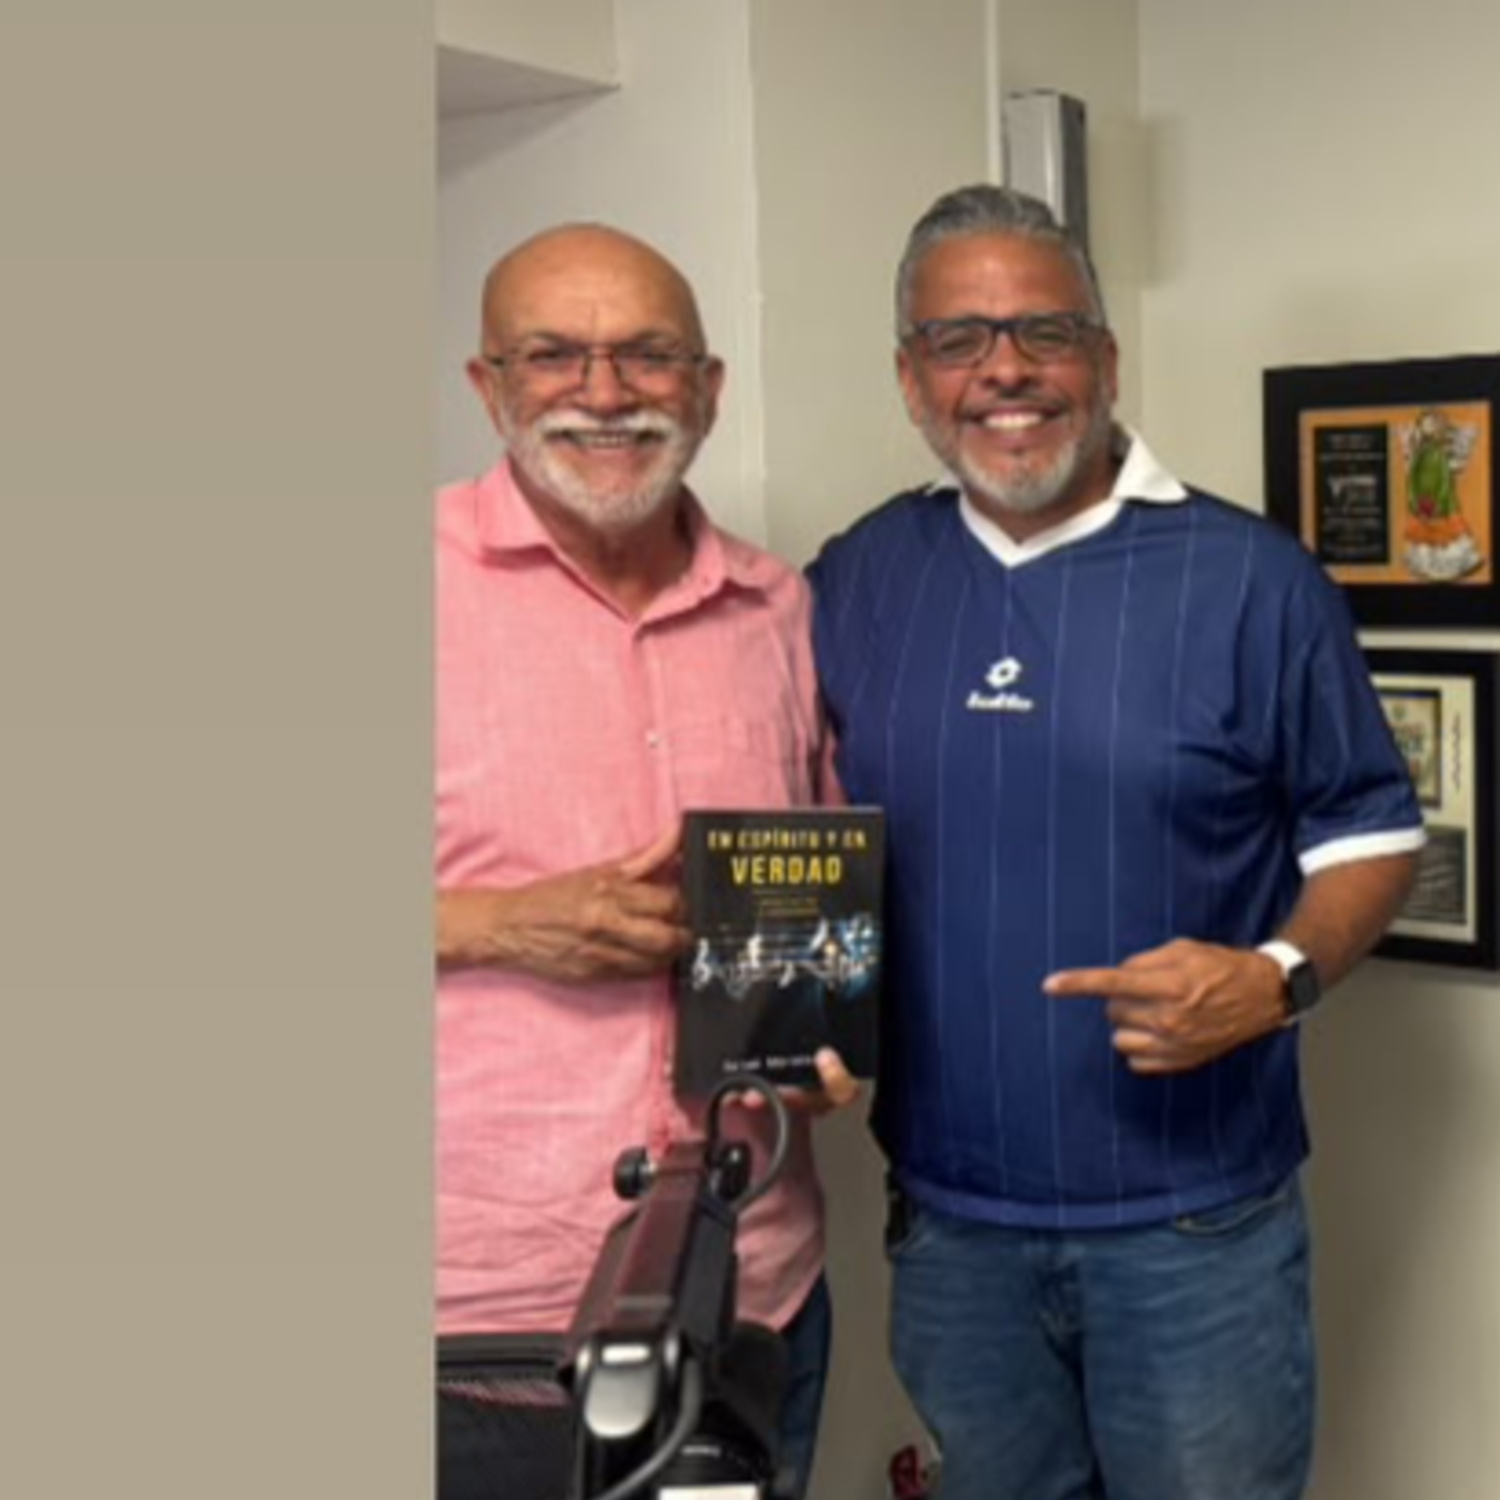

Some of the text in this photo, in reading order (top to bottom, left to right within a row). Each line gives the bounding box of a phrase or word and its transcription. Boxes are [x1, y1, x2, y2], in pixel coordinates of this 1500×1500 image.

[707, 829, 733, 850] EN
[826, 830, 837, 849] Y
[731, 855, 844, 886] VERDAD
